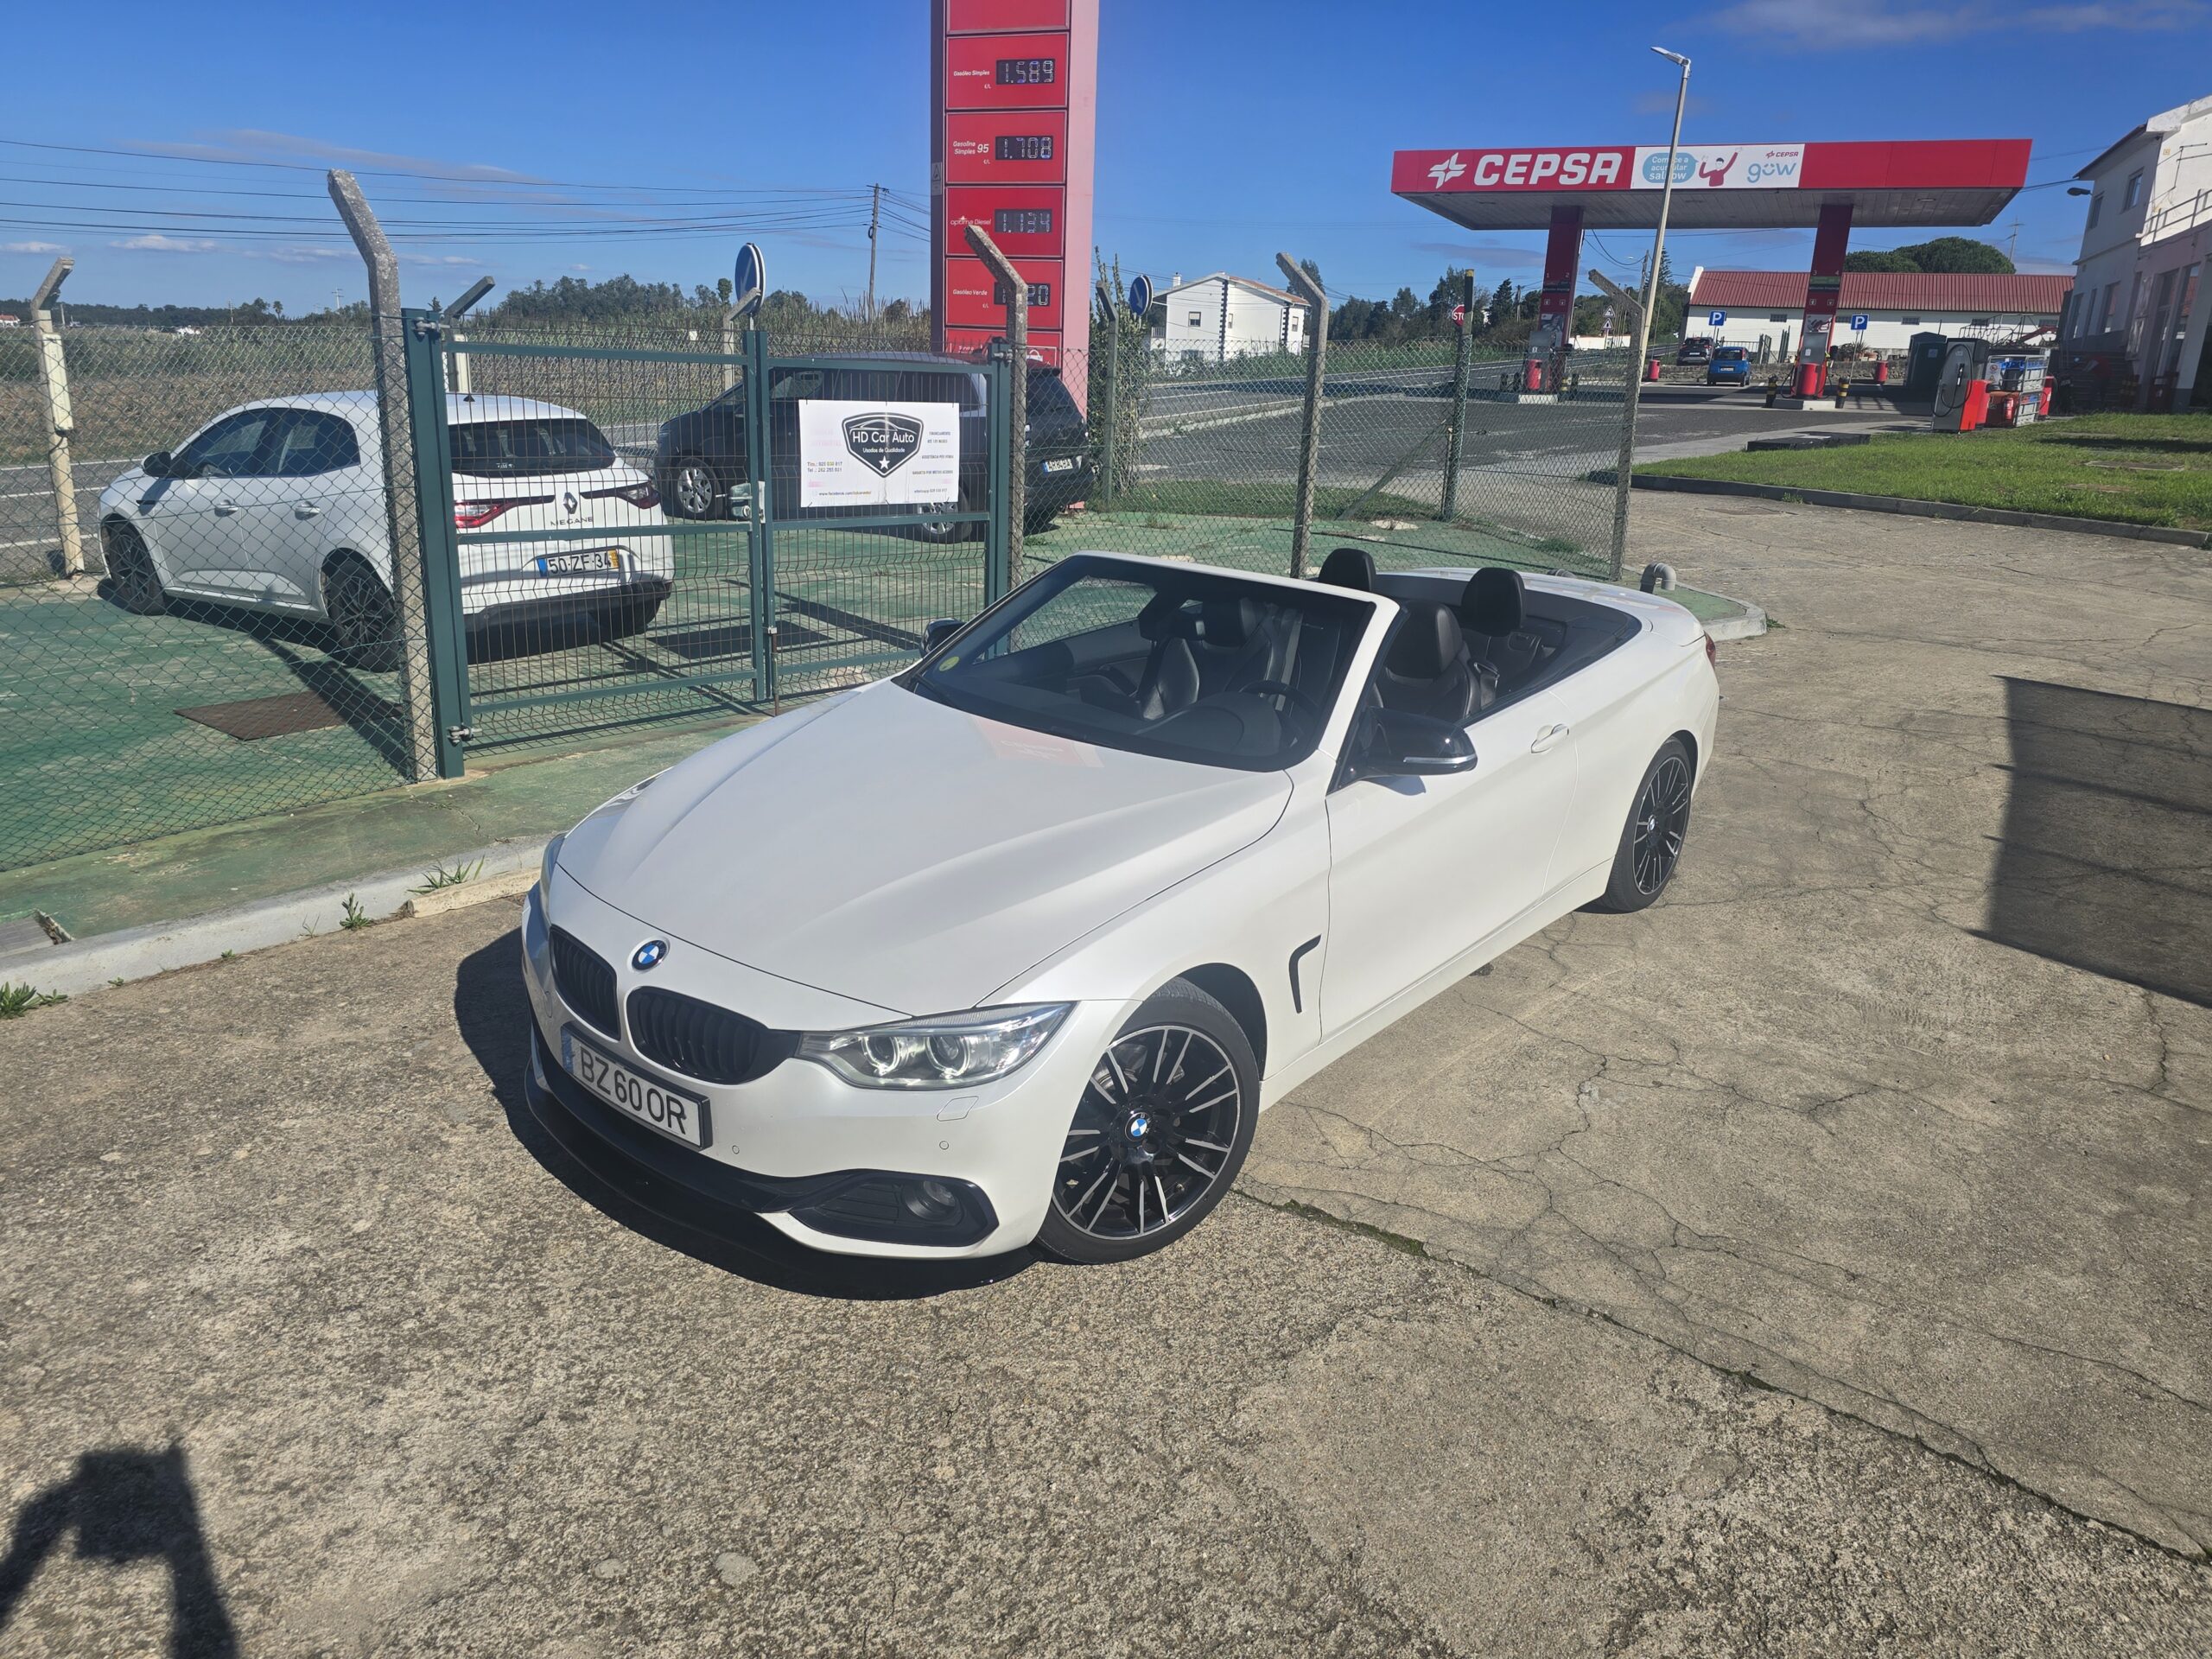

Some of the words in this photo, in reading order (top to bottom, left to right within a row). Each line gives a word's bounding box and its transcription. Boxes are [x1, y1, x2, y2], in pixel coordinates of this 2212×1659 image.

[1005, 60, 1054, 84] 1.589
[977, 143, 989, 153] 95
[1004, 137, 1052, 159] 1.708
[1473, 152, 1623, 186] CEPSA
[1712, 312, 1722, 325] P
[1854, 316, 1865, 328] P
[852, 431, 868, 442] HD
[871, 431, 889, 443] Car
[892, 431, 915, 443] Auto
